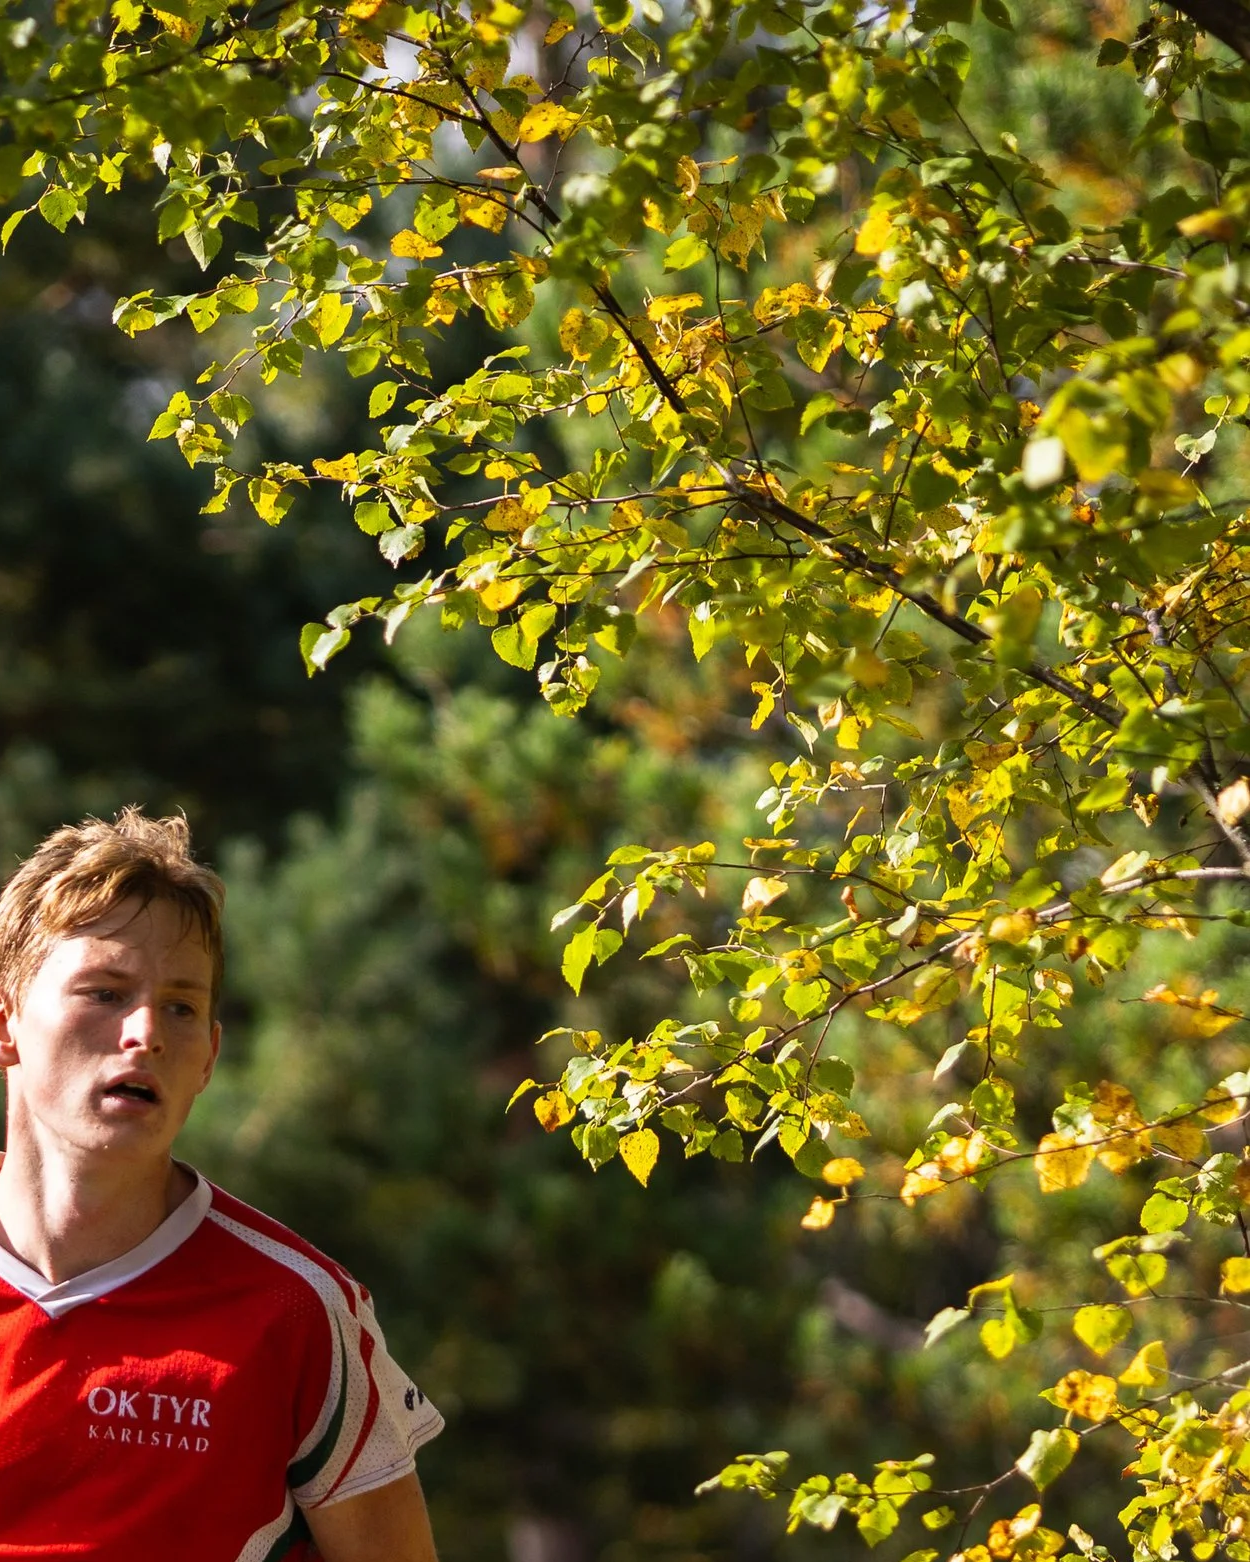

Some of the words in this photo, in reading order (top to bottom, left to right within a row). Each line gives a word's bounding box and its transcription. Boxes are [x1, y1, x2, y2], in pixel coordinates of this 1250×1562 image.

[88, 1386, 138, 1419] OK
[148, 1393, 211, 1427] TYR
[88, 1425, 210, 1452] KARLSTAD
